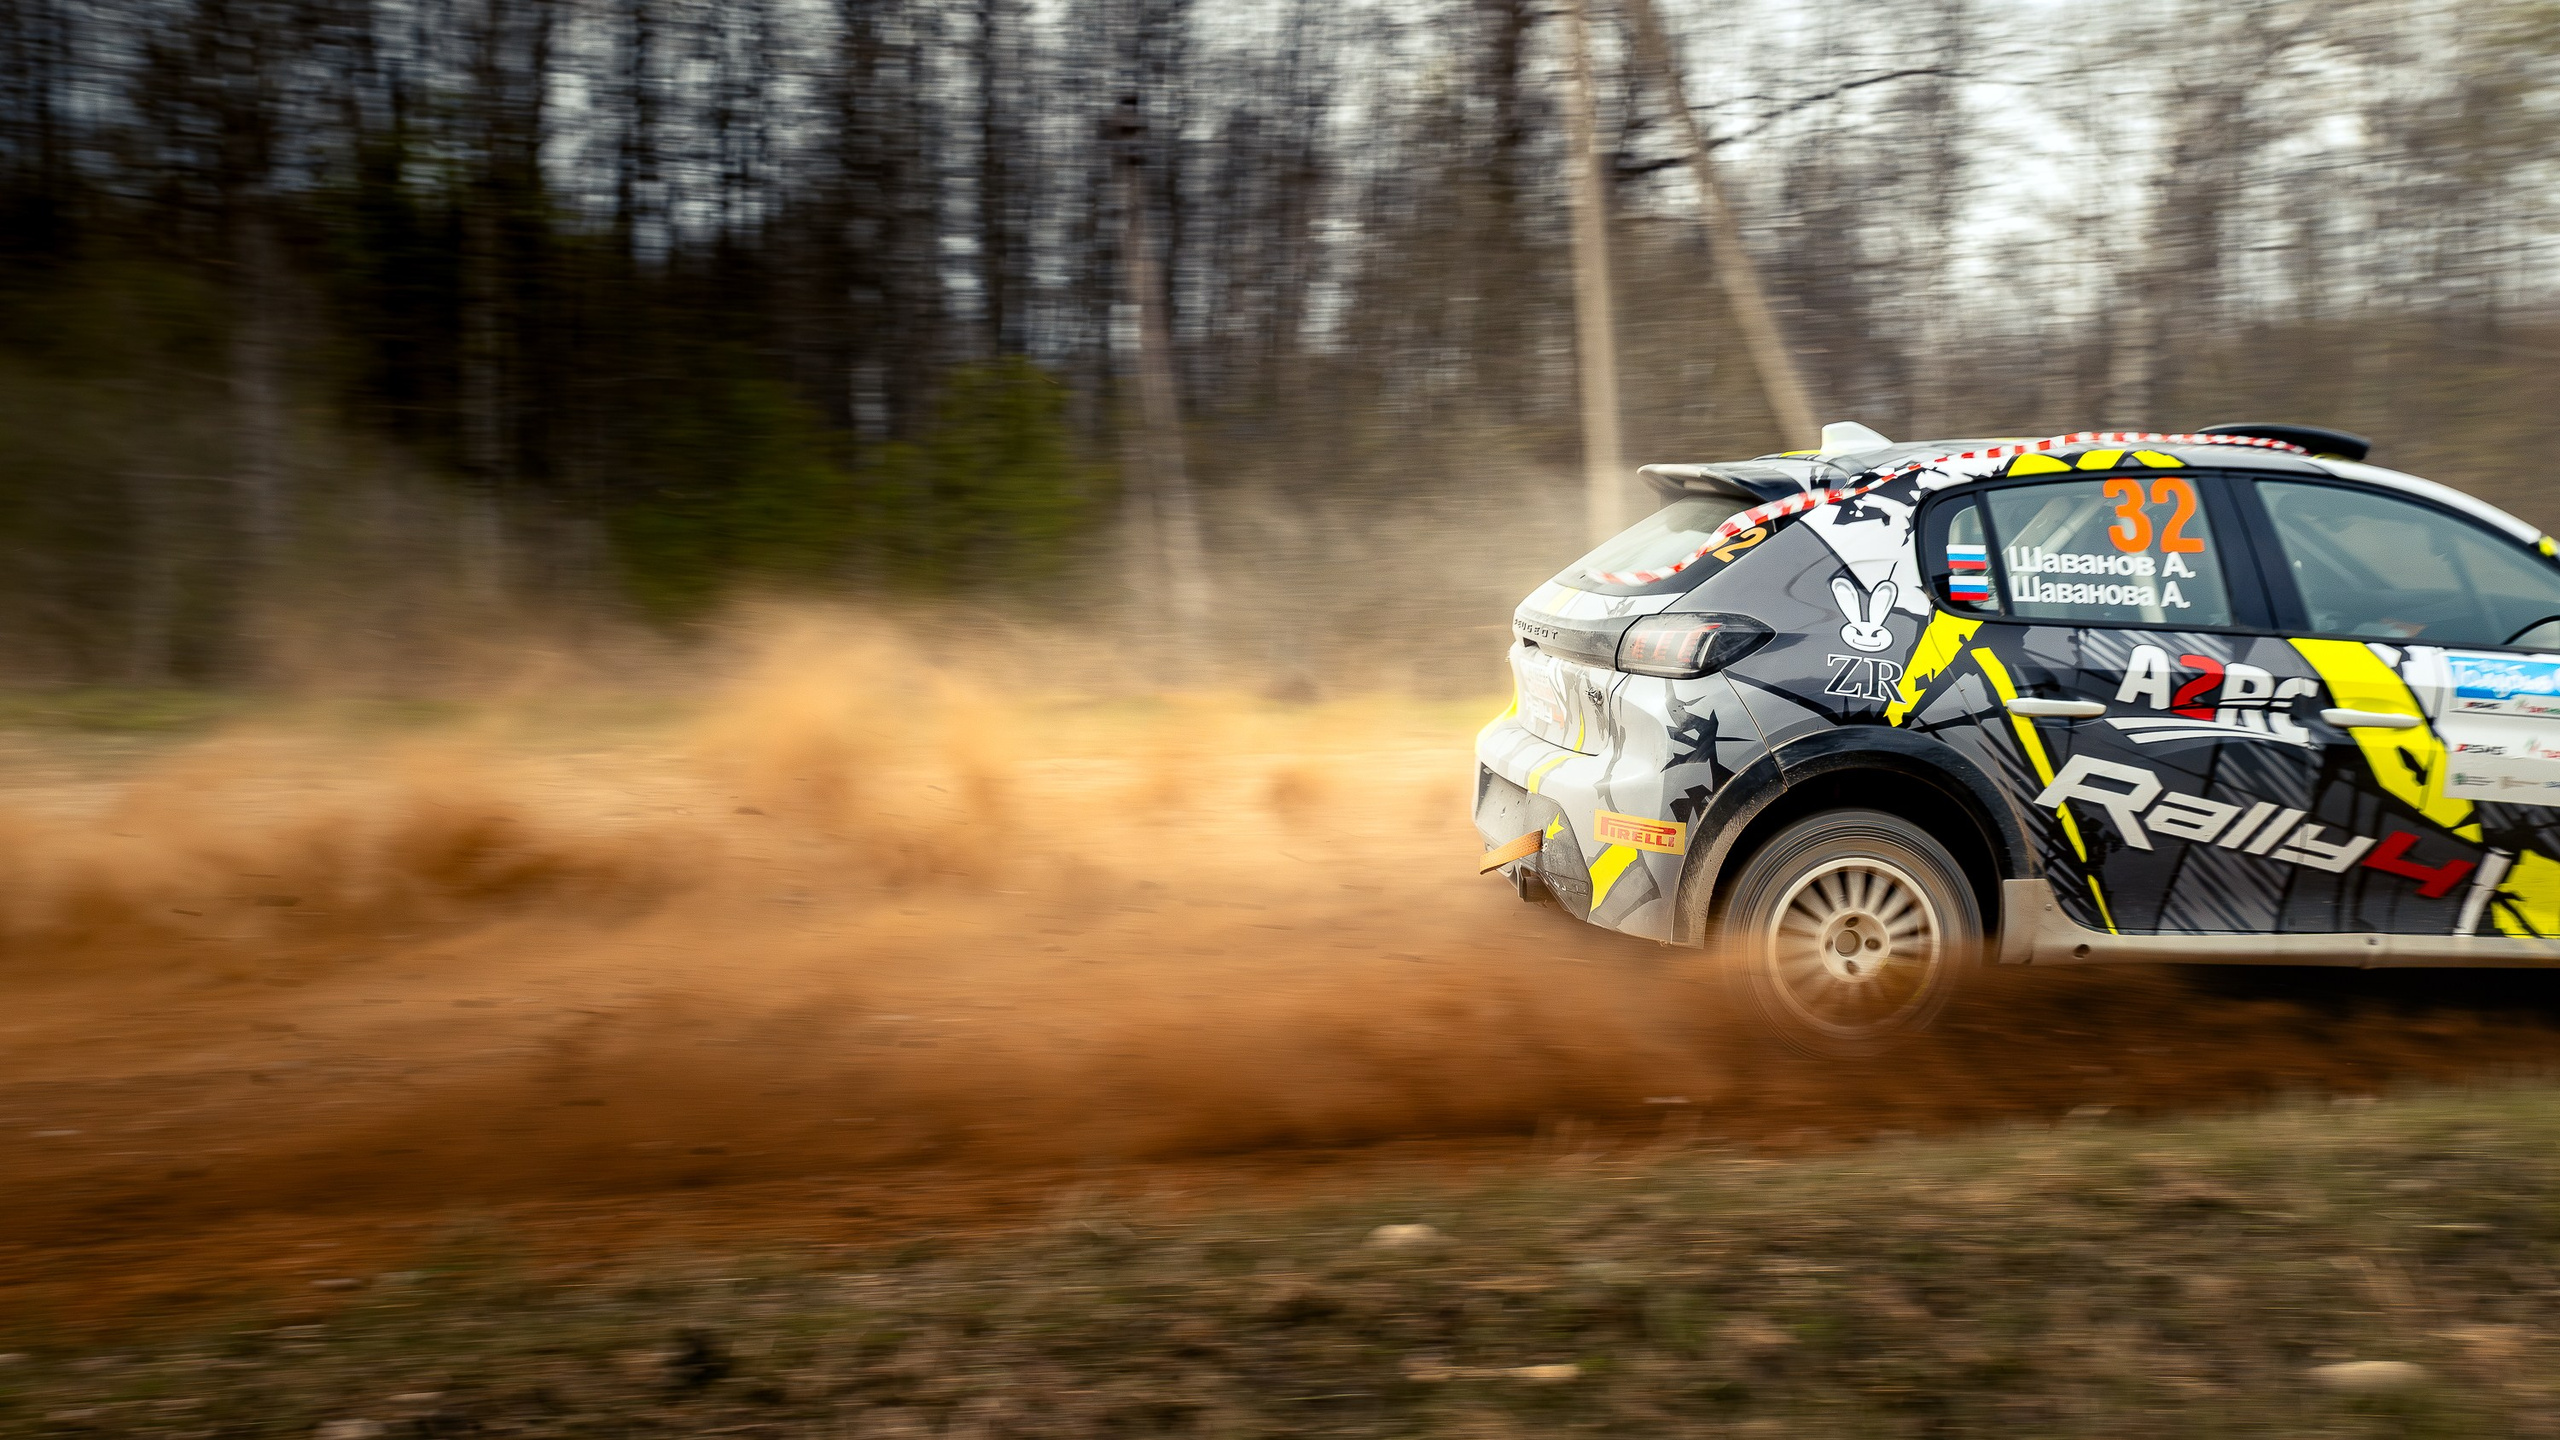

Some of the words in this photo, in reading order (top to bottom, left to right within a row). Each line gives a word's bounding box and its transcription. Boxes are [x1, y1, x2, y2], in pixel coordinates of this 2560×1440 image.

[2102, 477, 2205, 553] 32
[1706, 527, 1767, 563] 2
[2009, 545, 2156, 577] Шаванов
[2161, 551, 2196, 578] А.
[2010, 575, 2156, 606] Шаванова
[2160, 580, 2191, 608] А.
[1824, 653, 1907, 705] ZR
[2115, 644, 2319, 744] A2RC
[1600, 816, 1677, 847] PIRELLI
